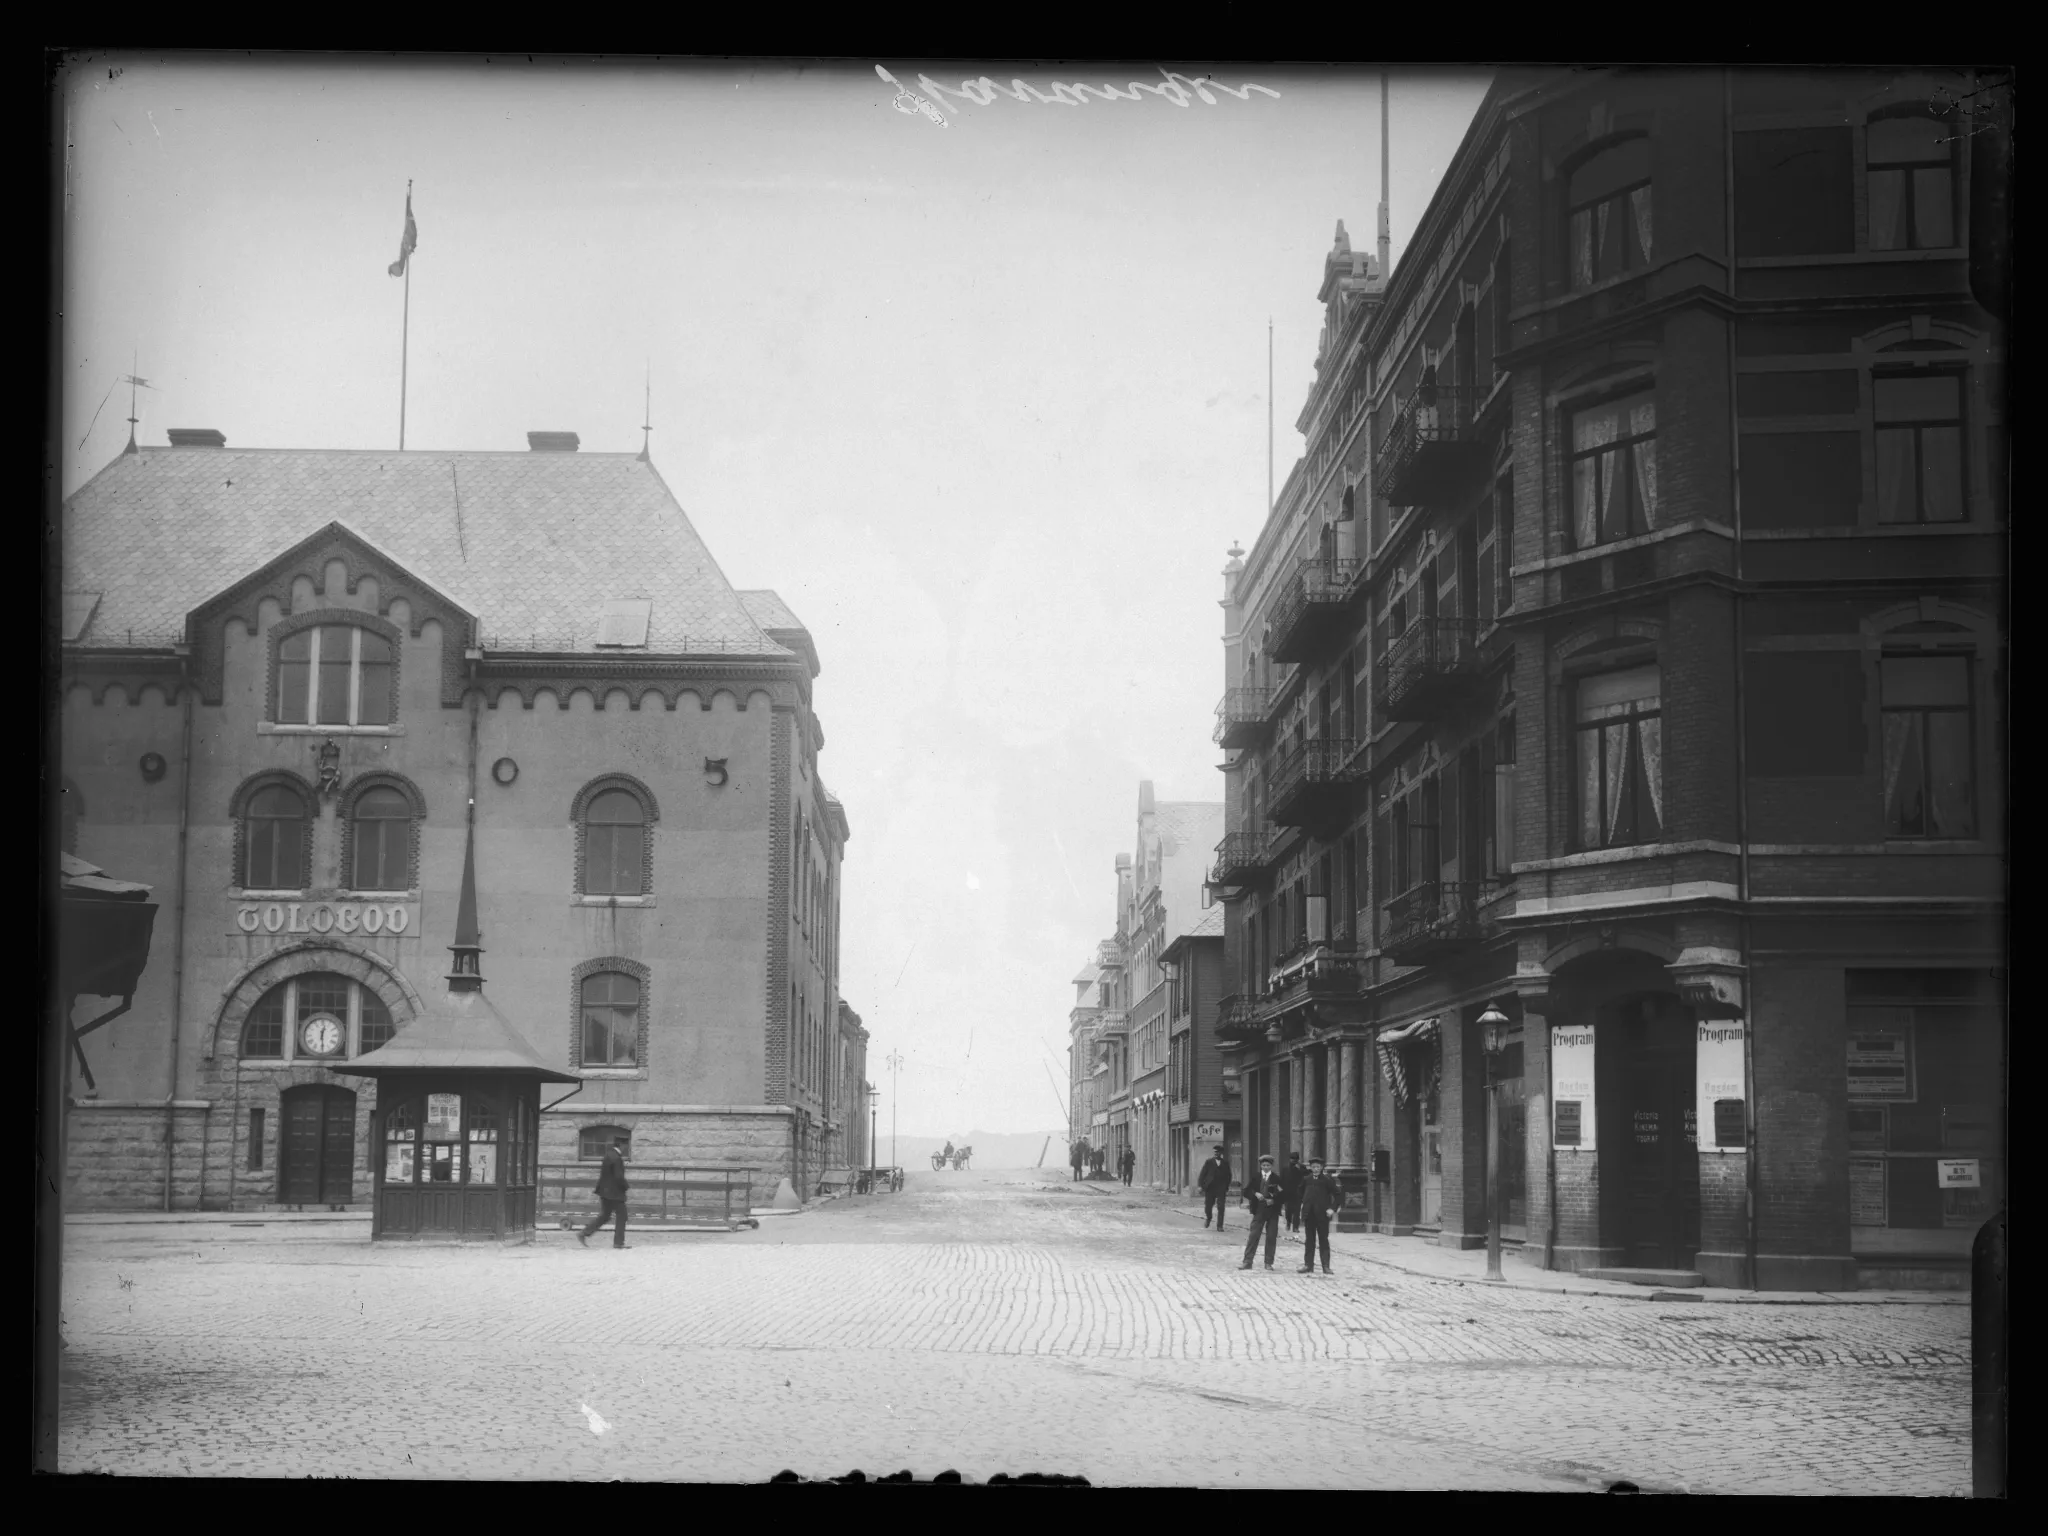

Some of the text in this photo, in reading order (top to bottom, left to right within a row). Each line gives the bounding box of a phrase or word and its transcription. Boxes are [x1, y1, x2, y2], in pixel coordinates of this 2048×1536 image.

[704, 756, 729, 787] 5
[1553, 1033, 1594, 1049] Program
[1699, 1027, 1743, 1045] Program
